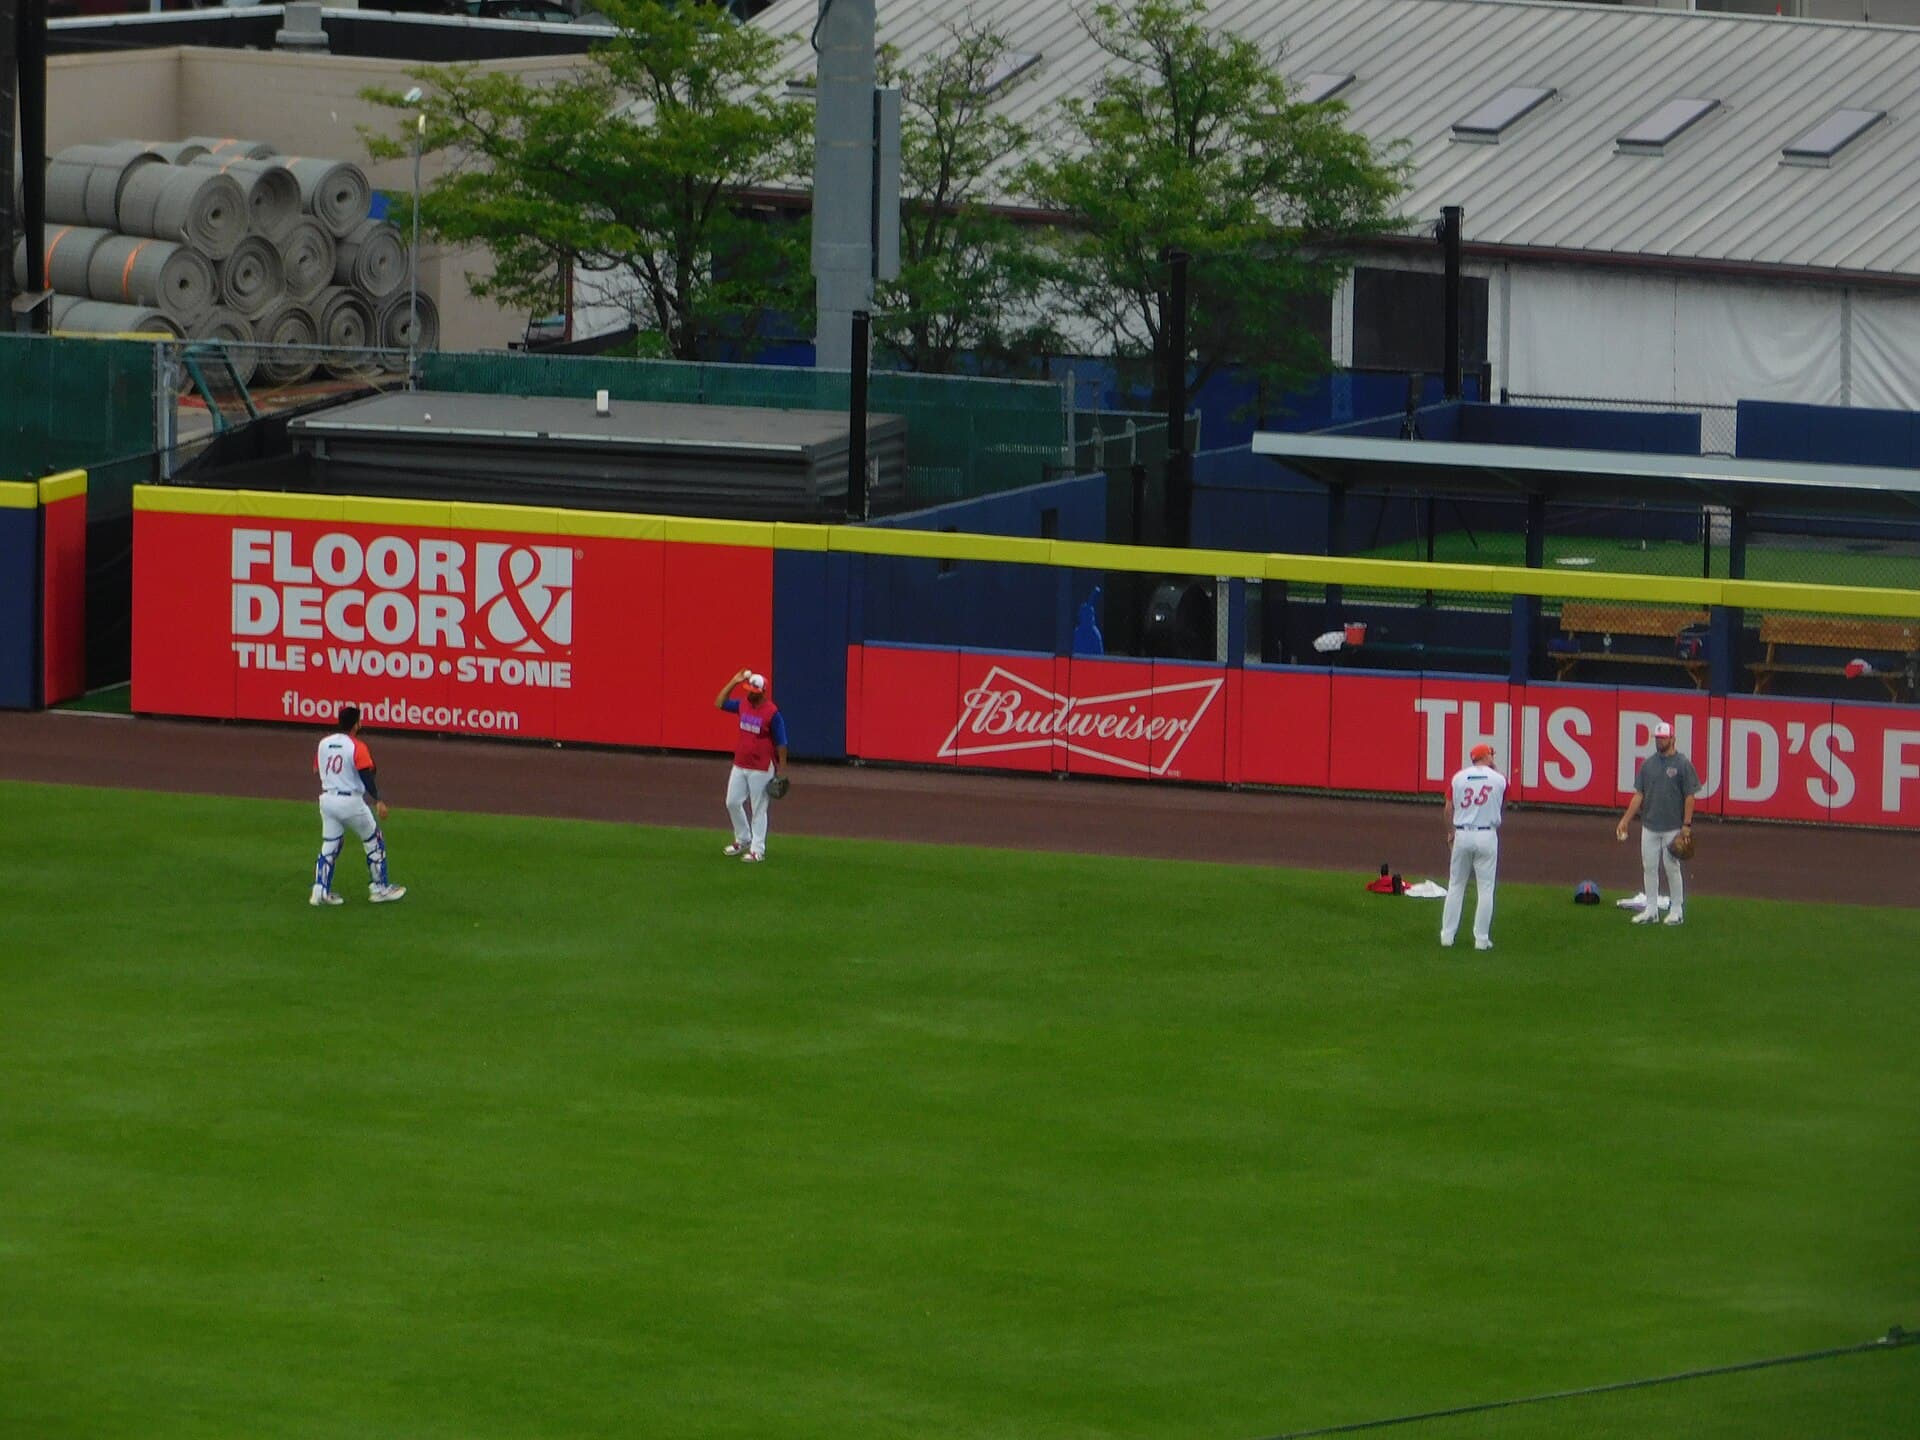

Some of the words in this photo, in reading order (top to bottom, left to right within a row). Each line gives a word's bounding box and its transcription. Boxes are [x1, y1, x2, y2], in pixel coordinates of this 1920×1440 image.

[231, 528, 465, 592] FLOOR
[231, 583, 465, 648] DECOR
[231, 642, 306, 671] TILE
[328, 648, 434, 679] WOOD
[457, 656, 572, 688] STONE
[963, 688, 1190, 741] Budweiser
[325, 754, 344, 777] 10
[1414, 698, 1592, 793] THIS
[1460, 784, 1493, 809] 35
